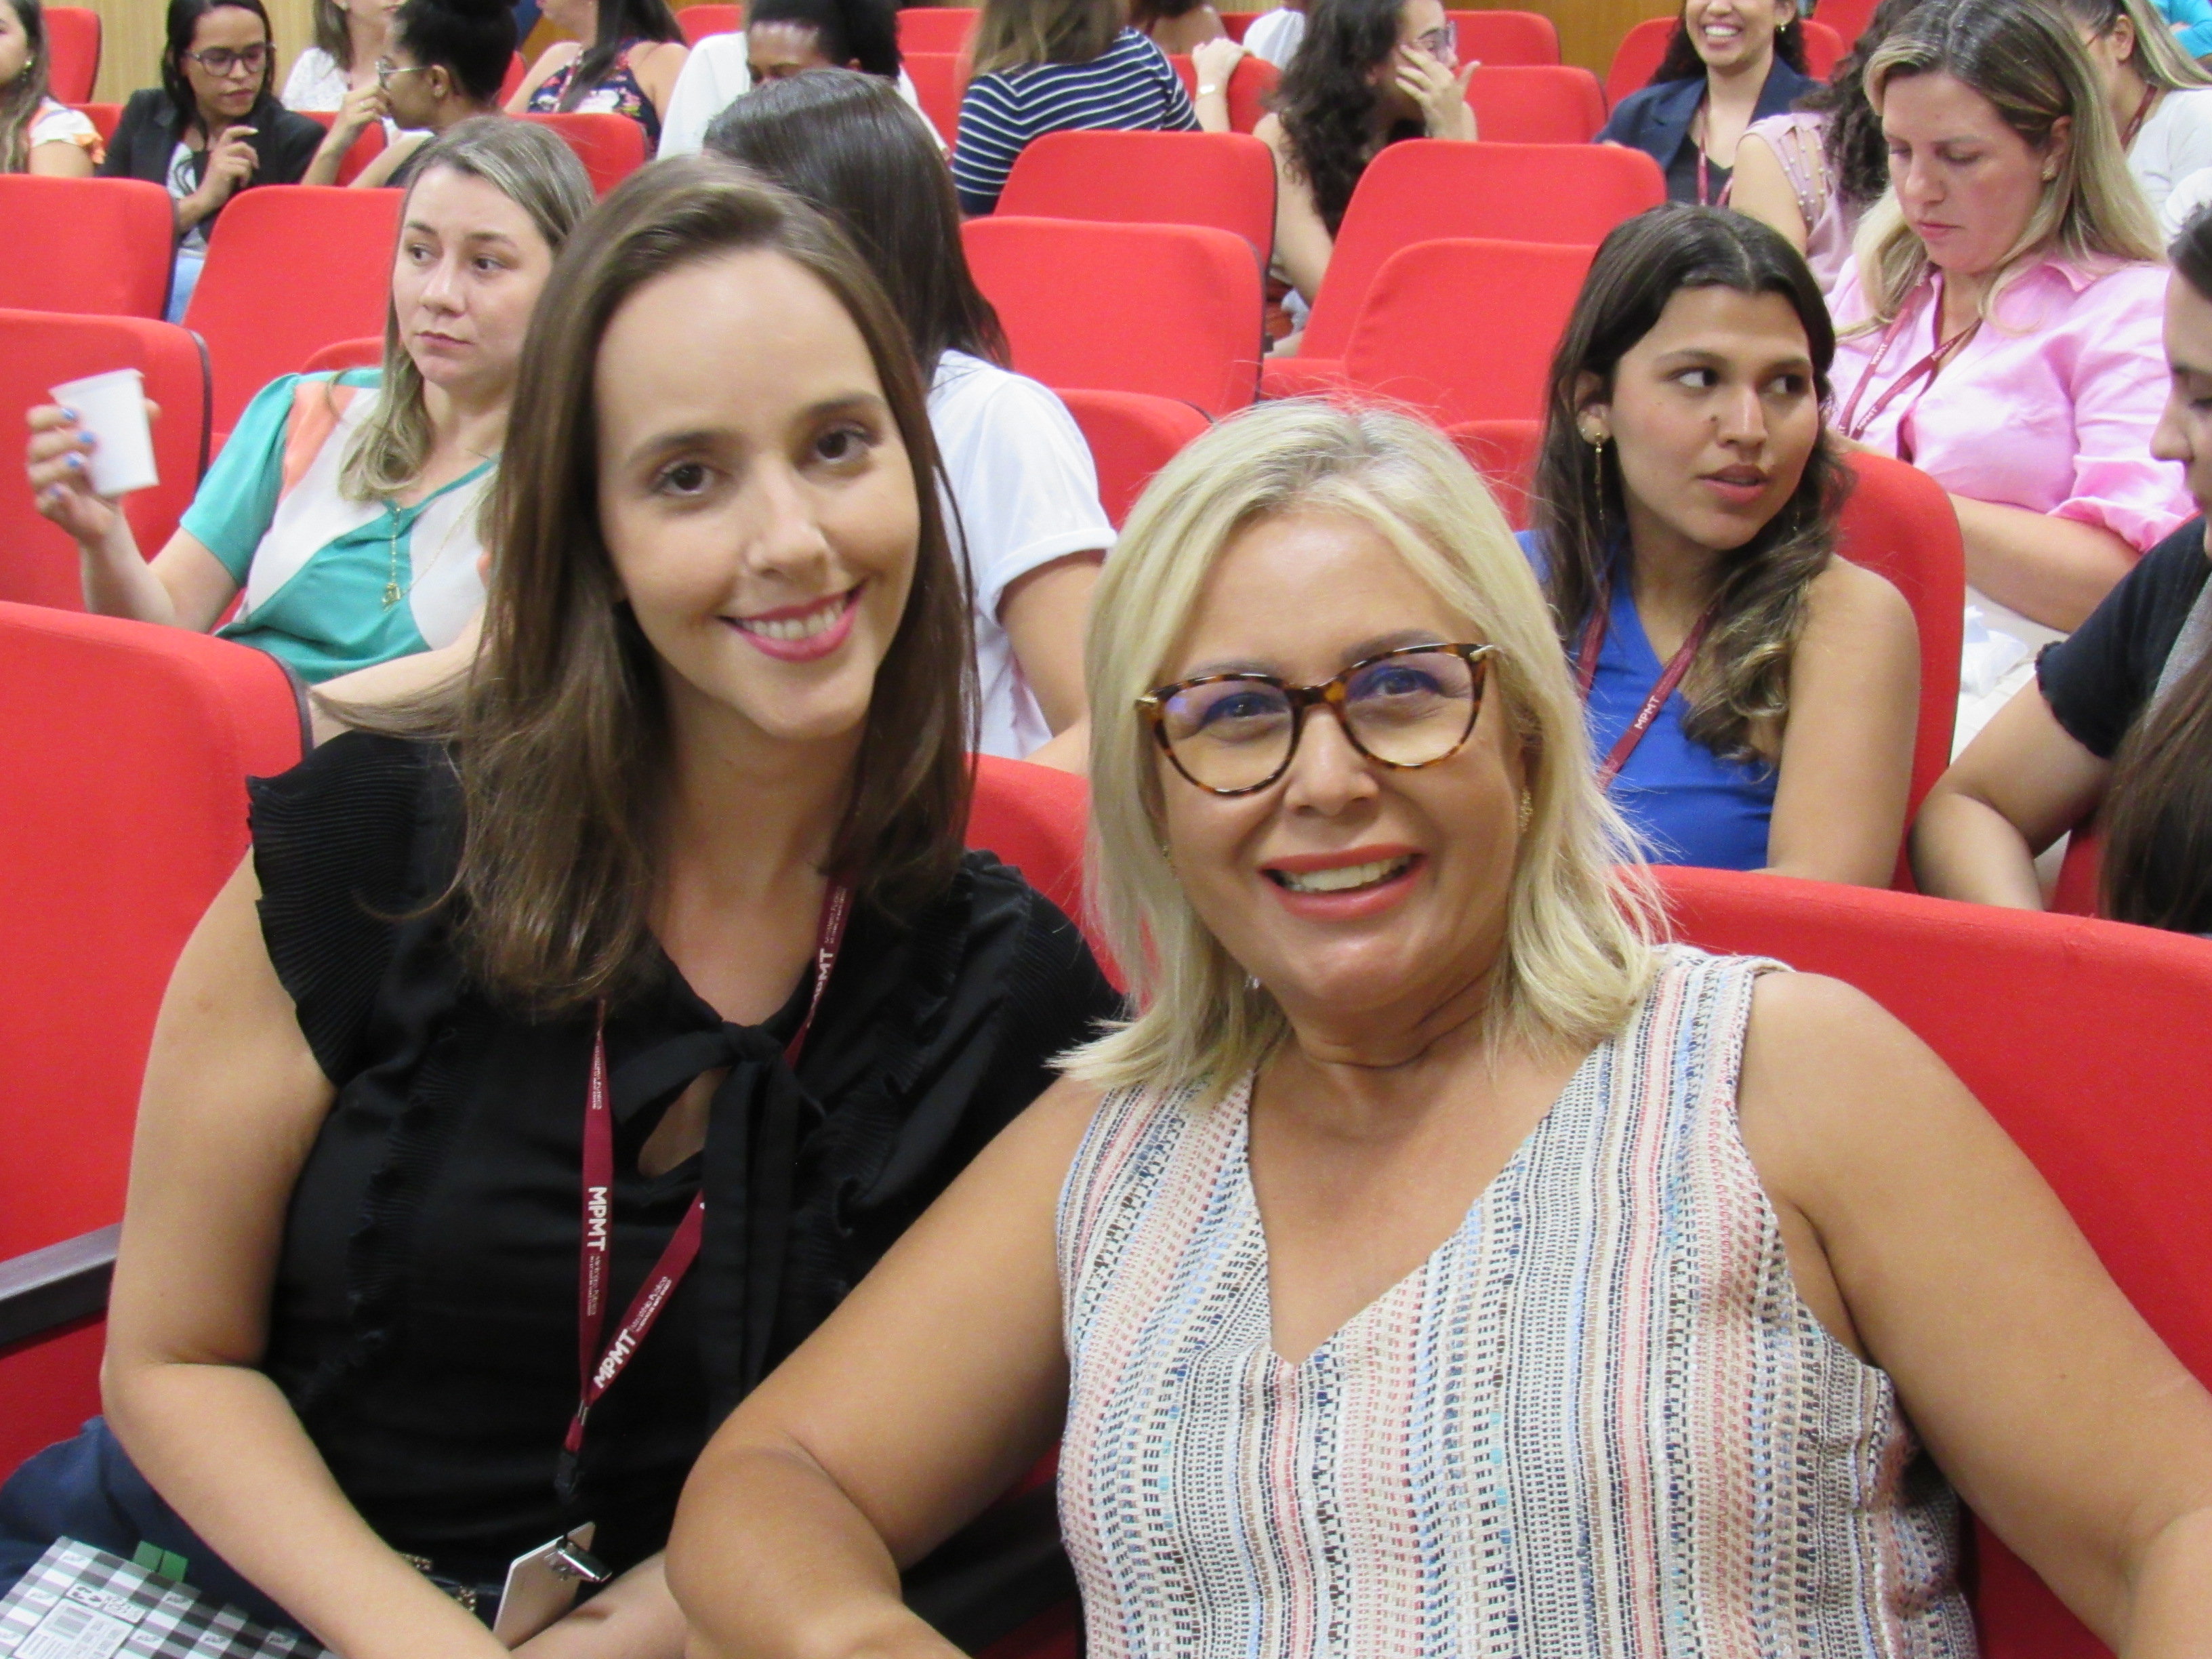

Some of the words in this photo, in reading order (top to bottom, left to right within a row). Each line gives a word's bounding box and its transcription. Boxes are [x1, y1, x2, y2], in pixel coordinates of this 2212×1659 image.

[1634, 695, 1660, 730] MPMT
[588, 1186, 608, 1252] MPMT
[593, 1328, 636, 1389] MPMT
